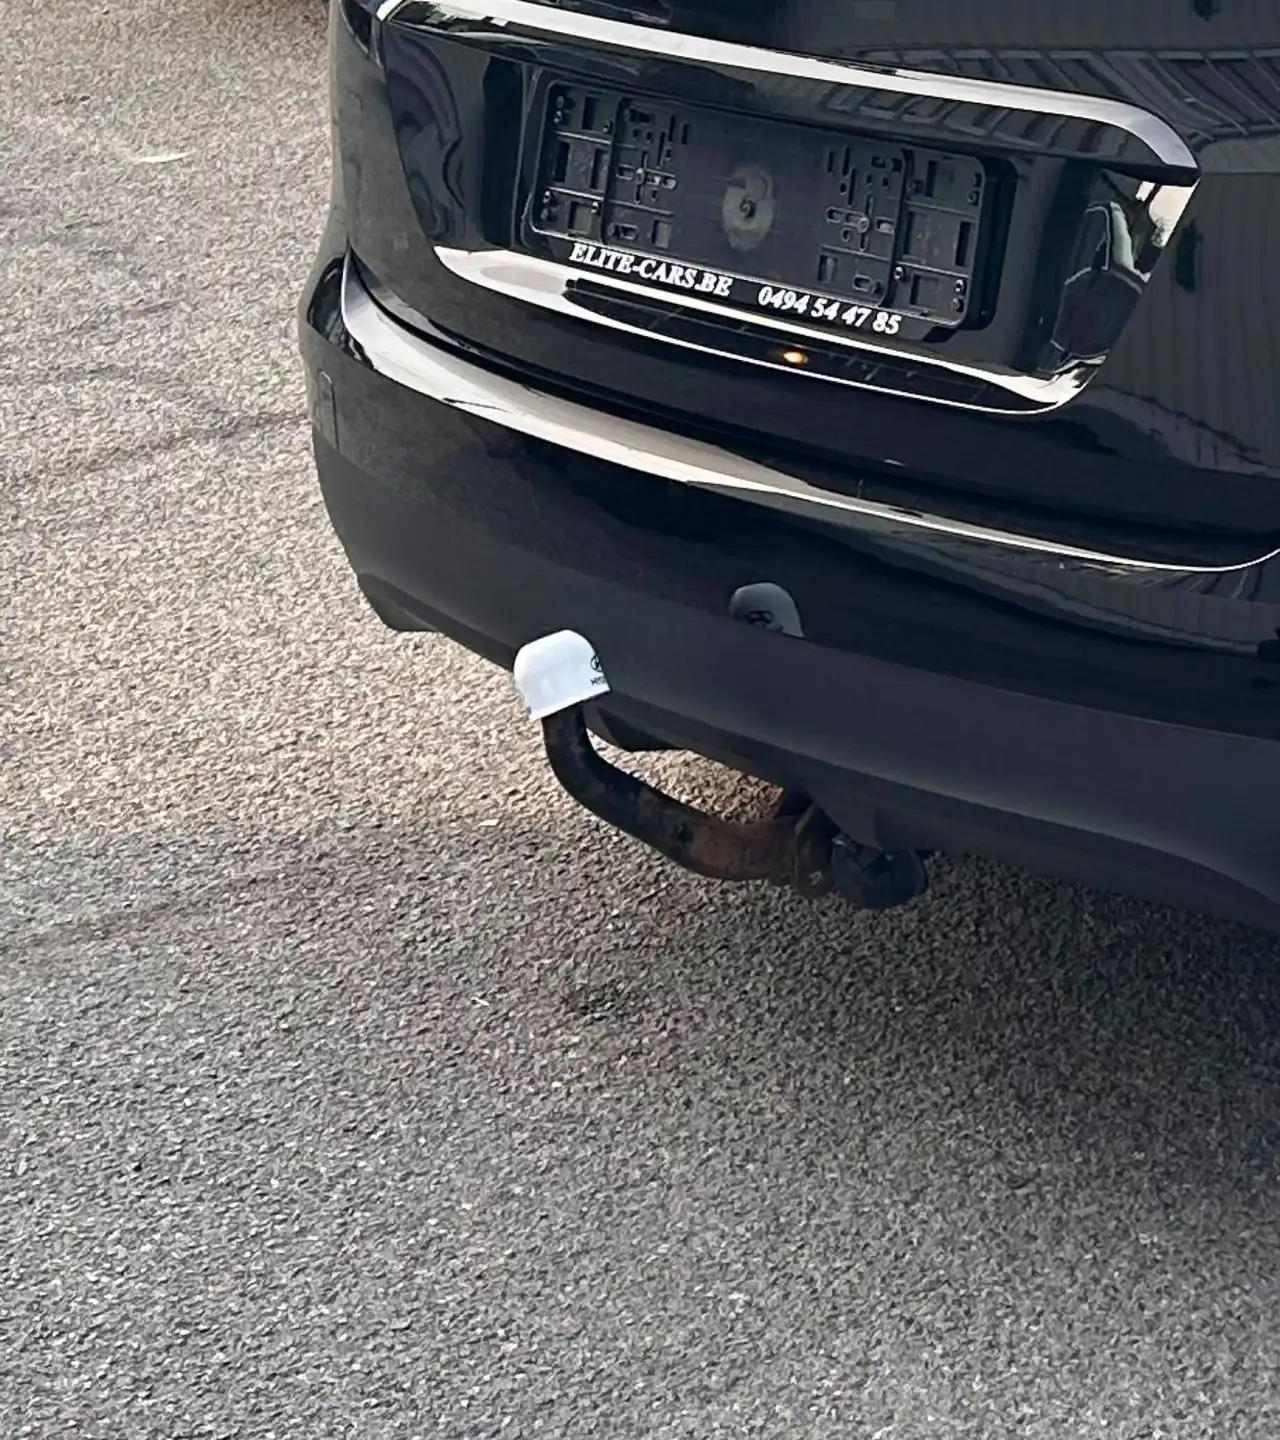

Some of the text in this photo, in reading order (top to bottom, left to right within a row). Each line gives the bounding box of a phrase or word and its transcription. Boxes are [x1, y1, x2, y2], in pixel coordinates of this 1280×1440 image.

[568, 241, 902, 335] ELITE-CARS.BE 0494 54 47 85
